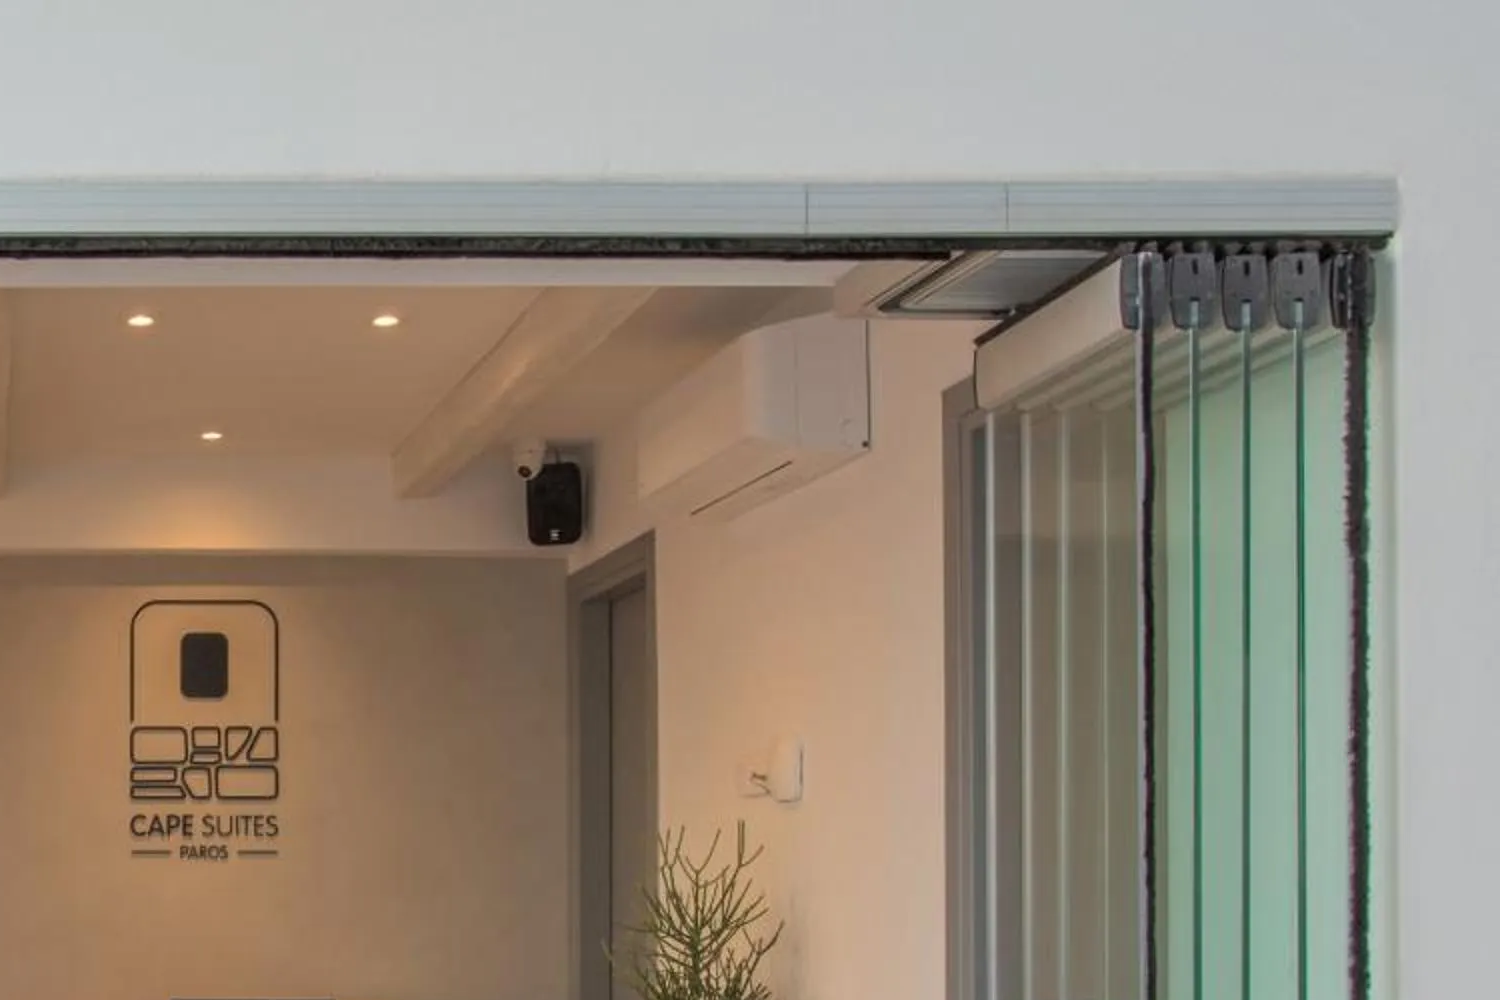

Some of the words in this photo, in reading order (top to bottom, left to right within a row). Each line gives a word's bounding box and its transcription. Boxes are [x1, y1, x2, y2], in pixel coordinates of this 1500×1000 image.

[130, 814, 194, 837] CAPE
[201, 814, 279, 837] SUITES
[179, 845, 229, 860] PAROS
